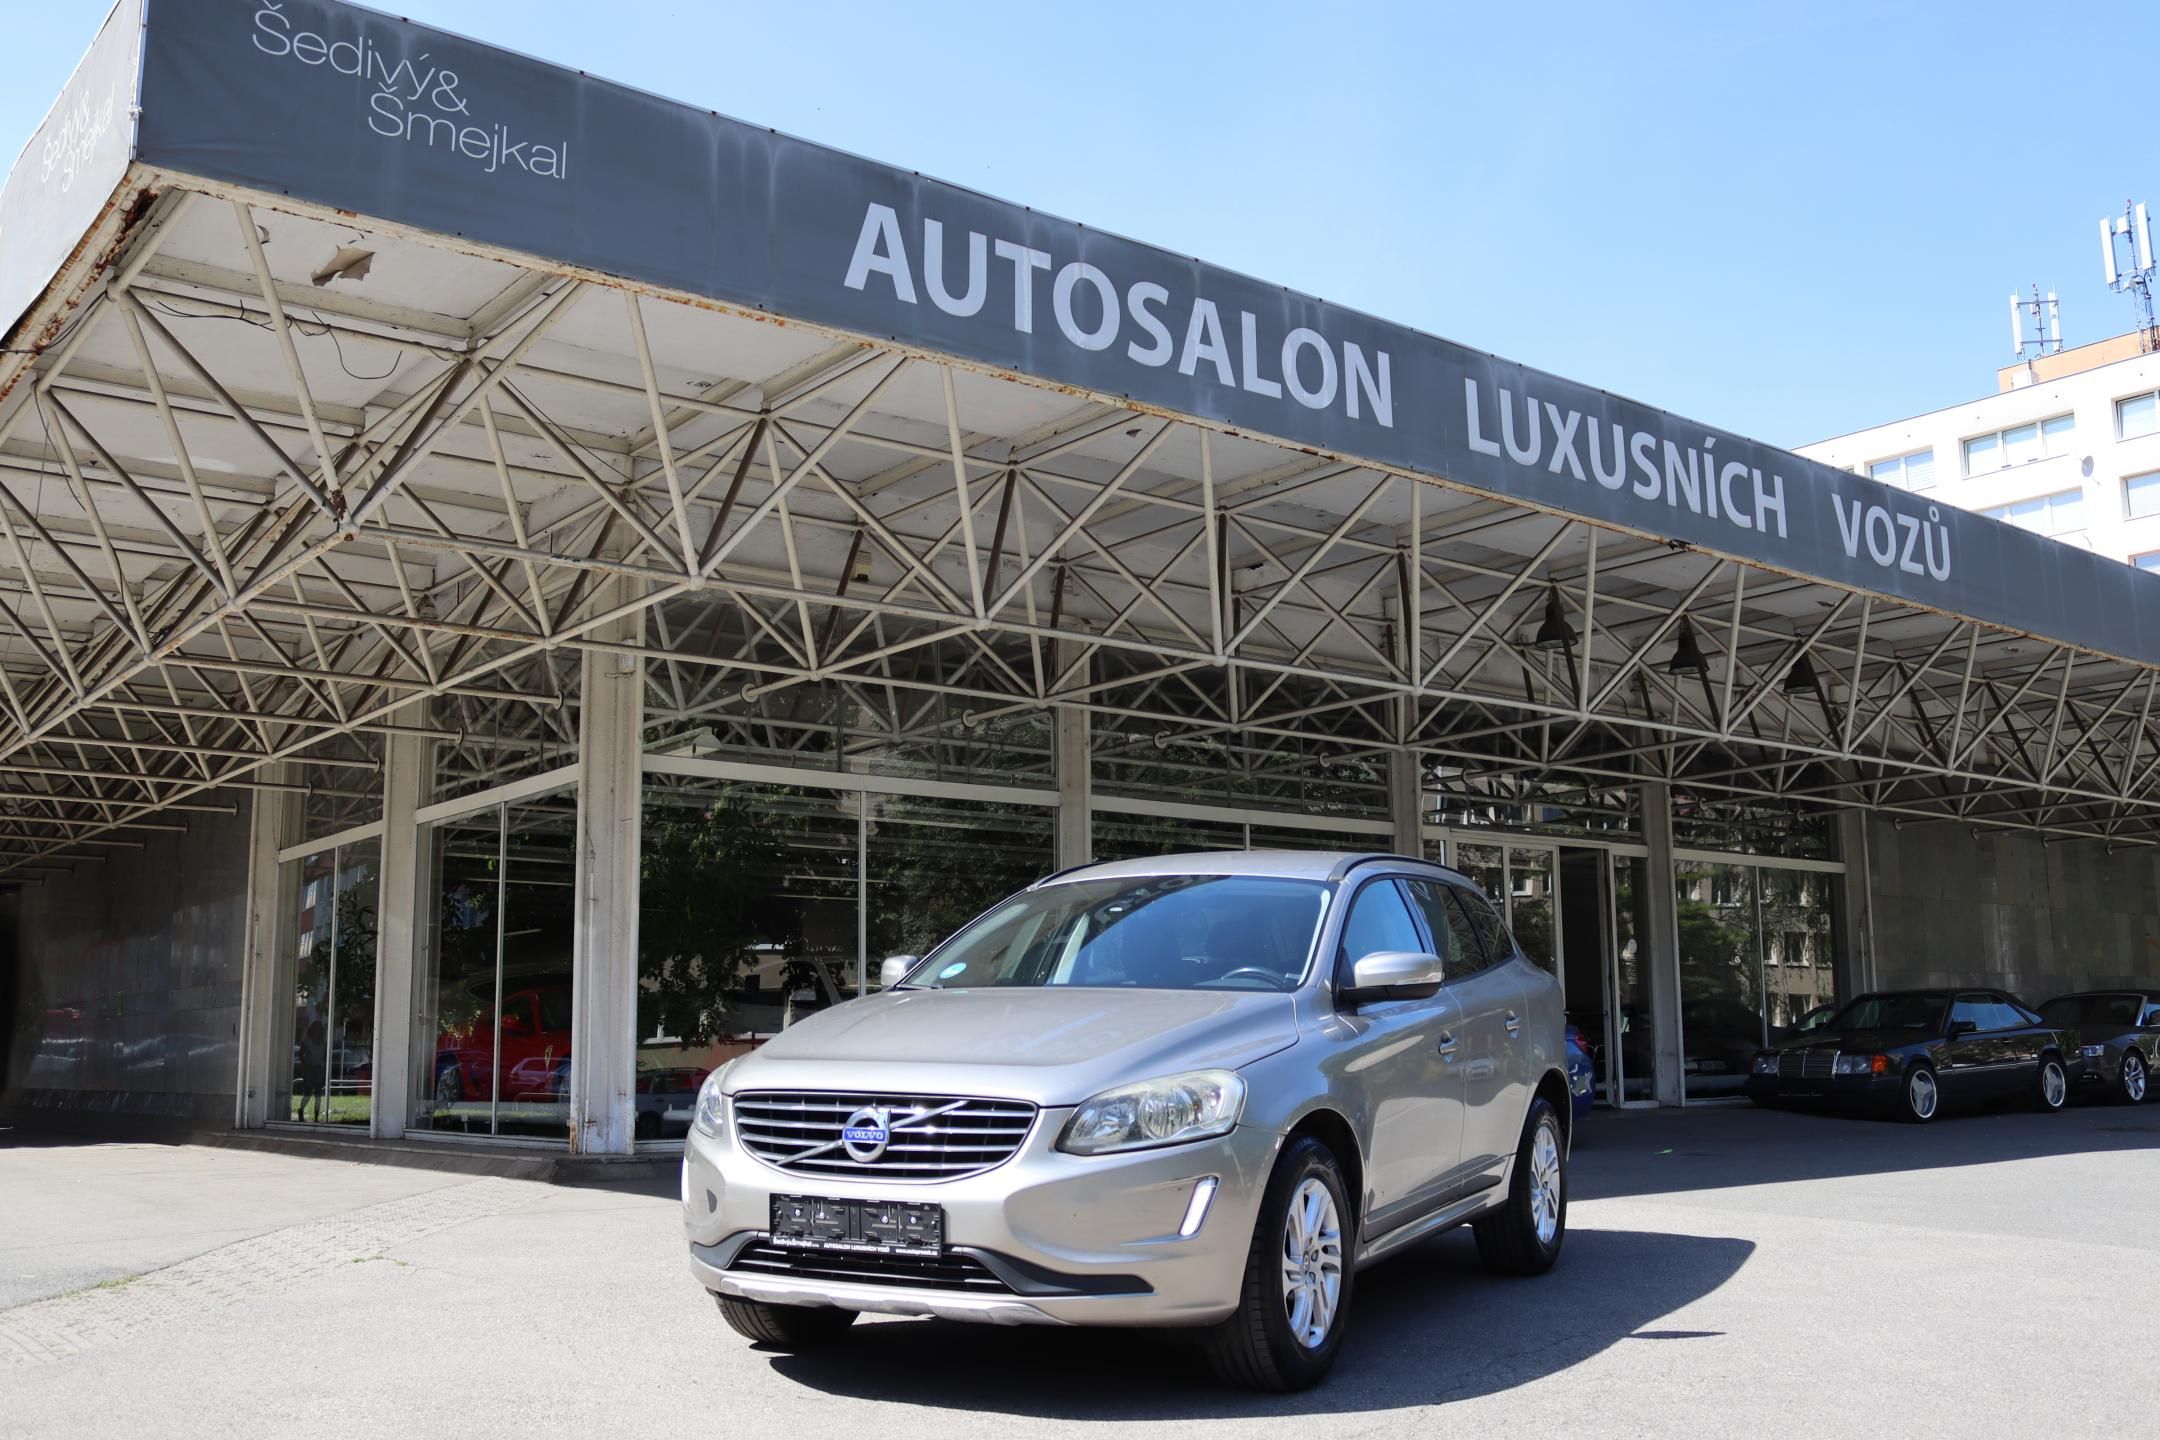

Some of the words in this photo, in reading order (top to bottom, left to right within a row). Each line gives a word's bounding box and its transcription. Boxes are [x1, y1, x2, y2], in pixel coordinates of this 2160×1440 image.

[253, 0, 470, 117] Šedivý&
[368, 81, 567, 180] Šmejkal
[843, 201, 1394, 429] AUTOSALON
[1464, 377, 1789, 540] LUXUSNÍCH
[1831, 493, 1952, 582] VOZŮ
[846, 1130, 884, 1140] VOLVO
